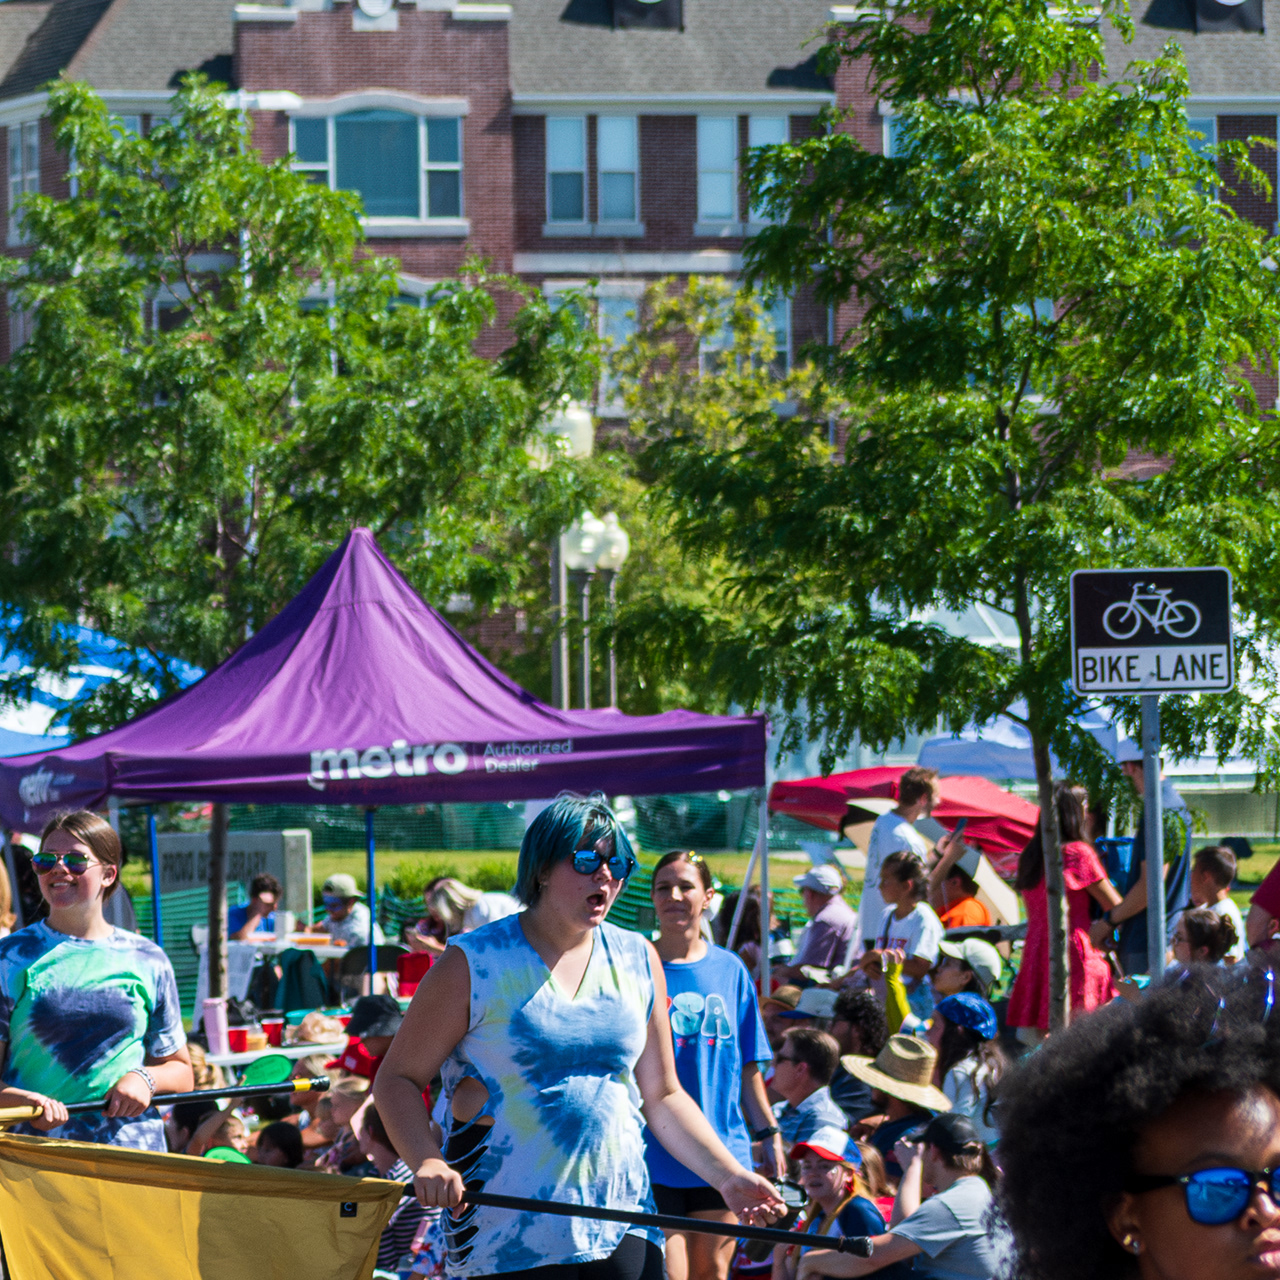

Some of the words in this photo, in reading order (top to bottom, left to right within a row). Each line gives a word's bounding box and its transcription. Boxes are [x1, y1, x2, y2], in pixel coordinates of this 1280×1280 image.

[1082, 656, 1140, 683] BIKE
[1156, 653, 1224, 681] LANE
[307, 739, 469, 791] metro
[483, 739, 573, 759] Authorized
[484, 757, 540, 773] Dealer
[667, 992, 733, 1039] SA
